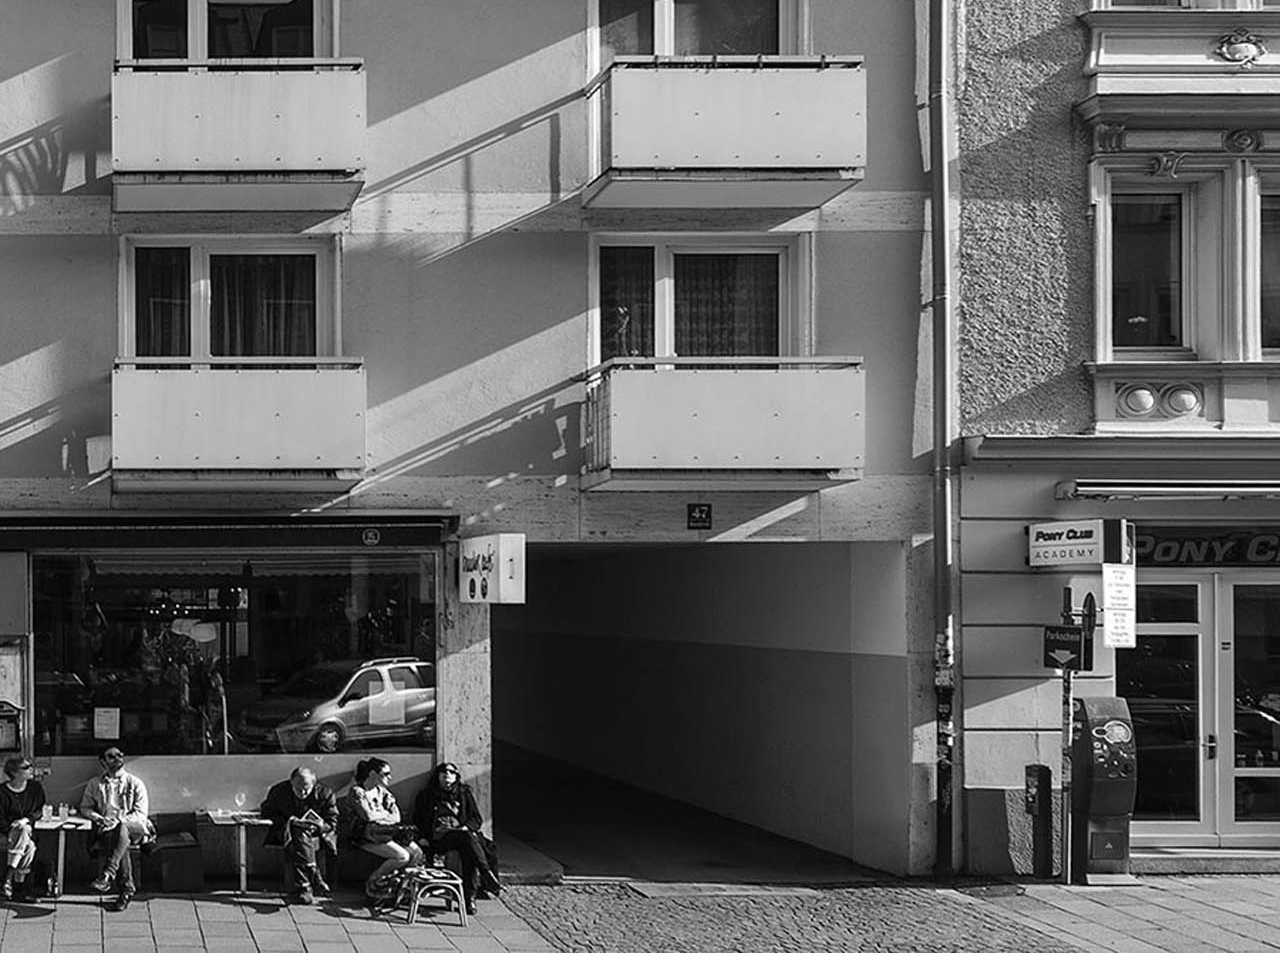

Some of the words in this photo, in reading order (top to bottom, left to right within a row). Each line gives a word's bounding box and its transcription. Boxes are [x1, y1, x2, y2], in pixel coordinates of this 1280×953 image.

[692, 507, 708, 518] 47
[1035, 530, 1064, 542] PONY
[1066, 528, 1094, 540] CLUB
[1035, 549, 1094, 559] ACADEMY
